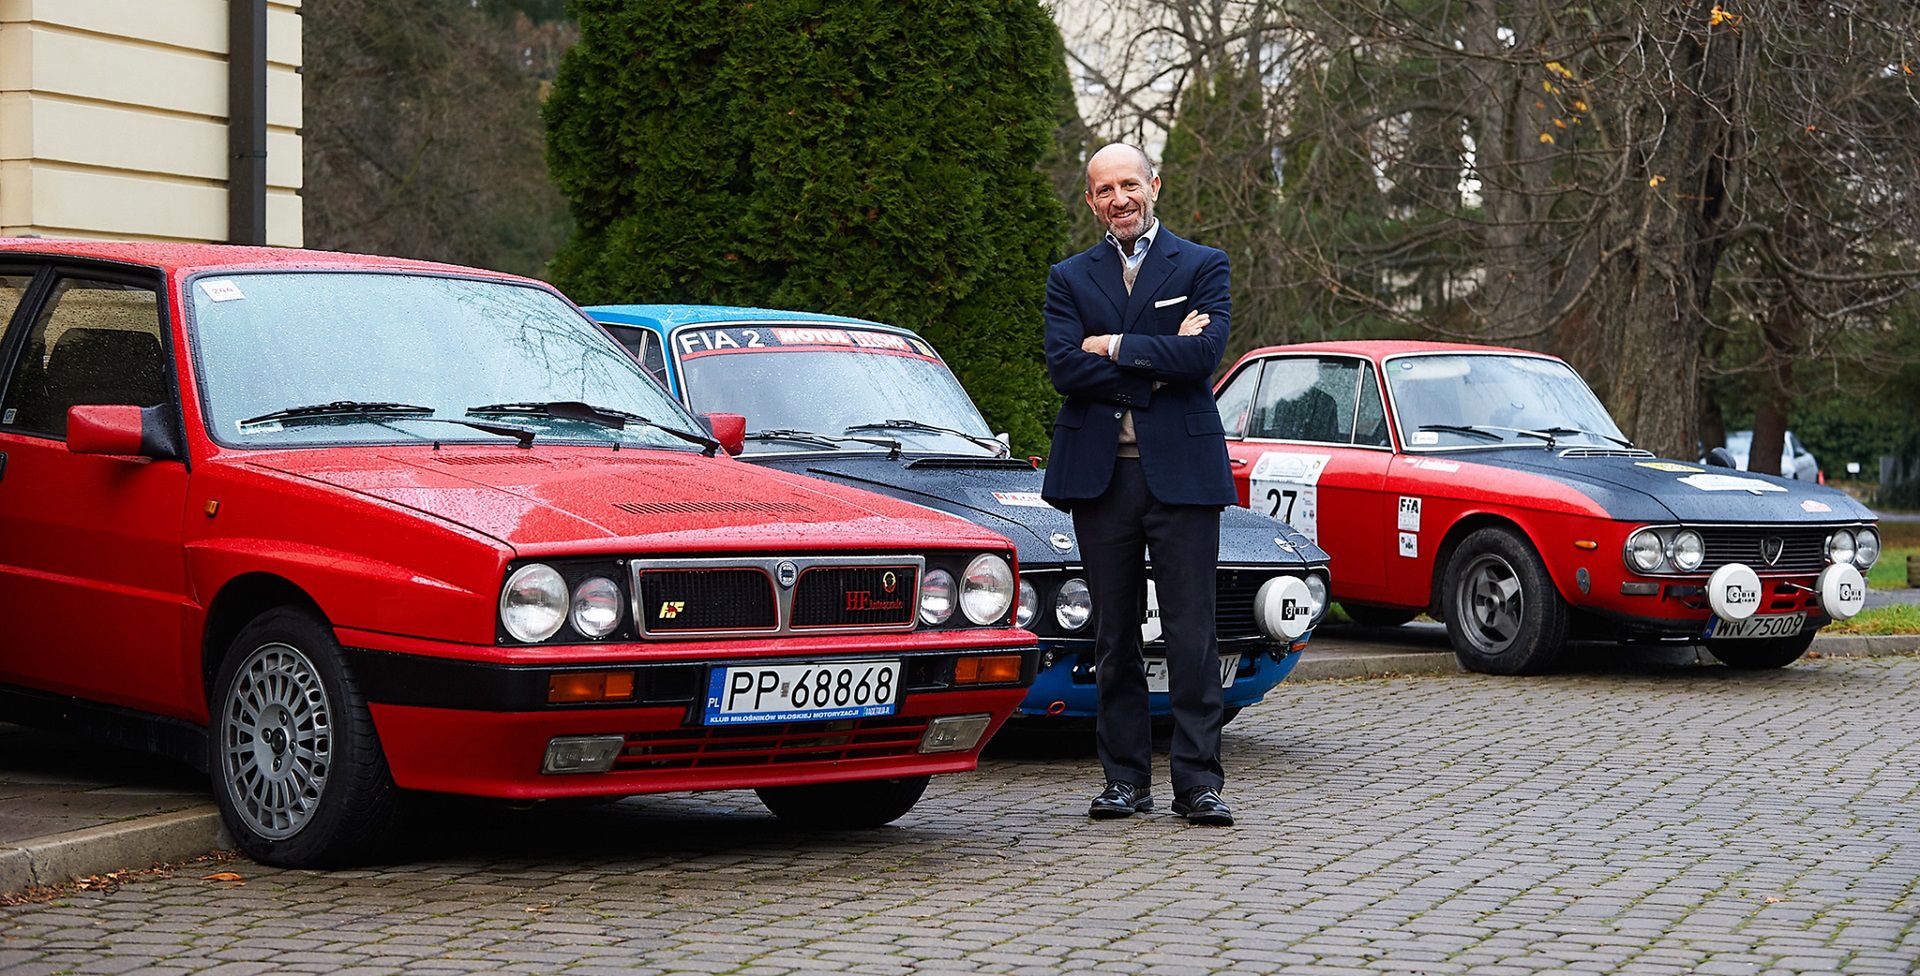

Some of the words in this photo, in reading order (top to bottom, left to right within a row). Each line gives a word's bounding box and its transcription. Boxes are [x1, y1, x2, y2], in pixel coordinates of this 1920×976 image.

[678, 330, 740, 354] FIA
[742, 330, 765, 348] 2
[778, 330, 850, 344] MOTUL
[1266, 488, 1297, 525] 27
[659, 601, 685, 618] HF
[1747, 614, 1803, 636] 75009
[727, 671, 780, 711] PP
[791, 667, 893, 708] 68868
[707, 698, 720, 708] PL
[813, 709, 859, 718] MOTORYZACJI
